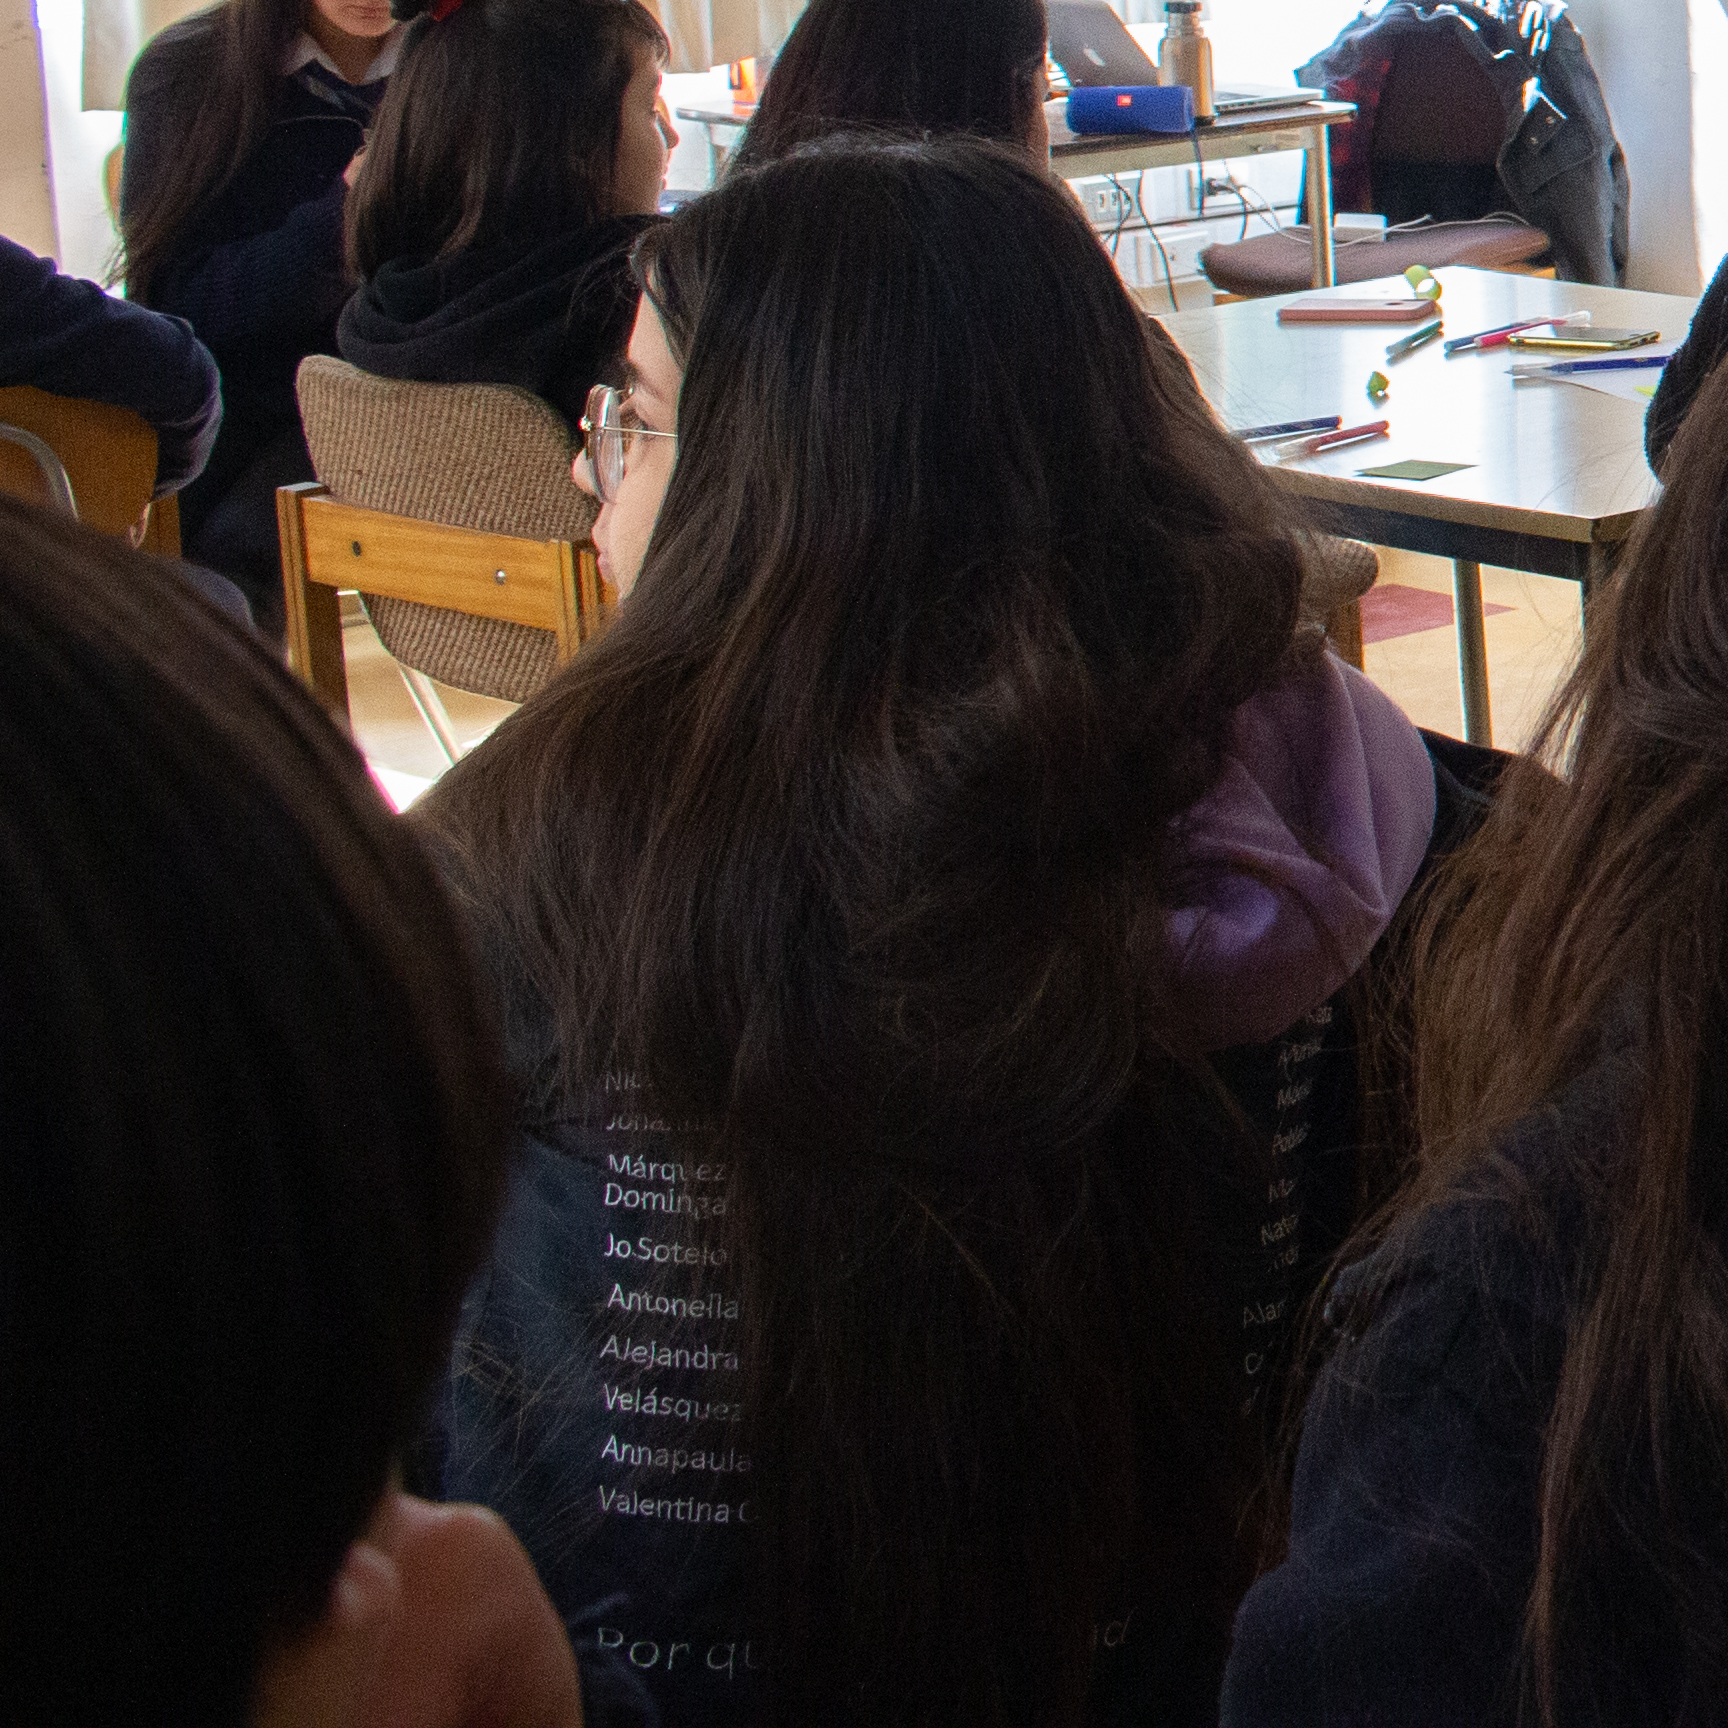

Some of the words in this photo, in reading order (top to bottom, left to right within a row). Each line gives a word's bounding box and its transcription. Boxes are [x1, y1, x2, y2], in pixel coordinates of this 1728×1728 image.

[607, 1283, 739, 1320] Antonella
[600, 1334, 739, 1371] Alejandra
[599, 1485, 729, 1523] Valentina
